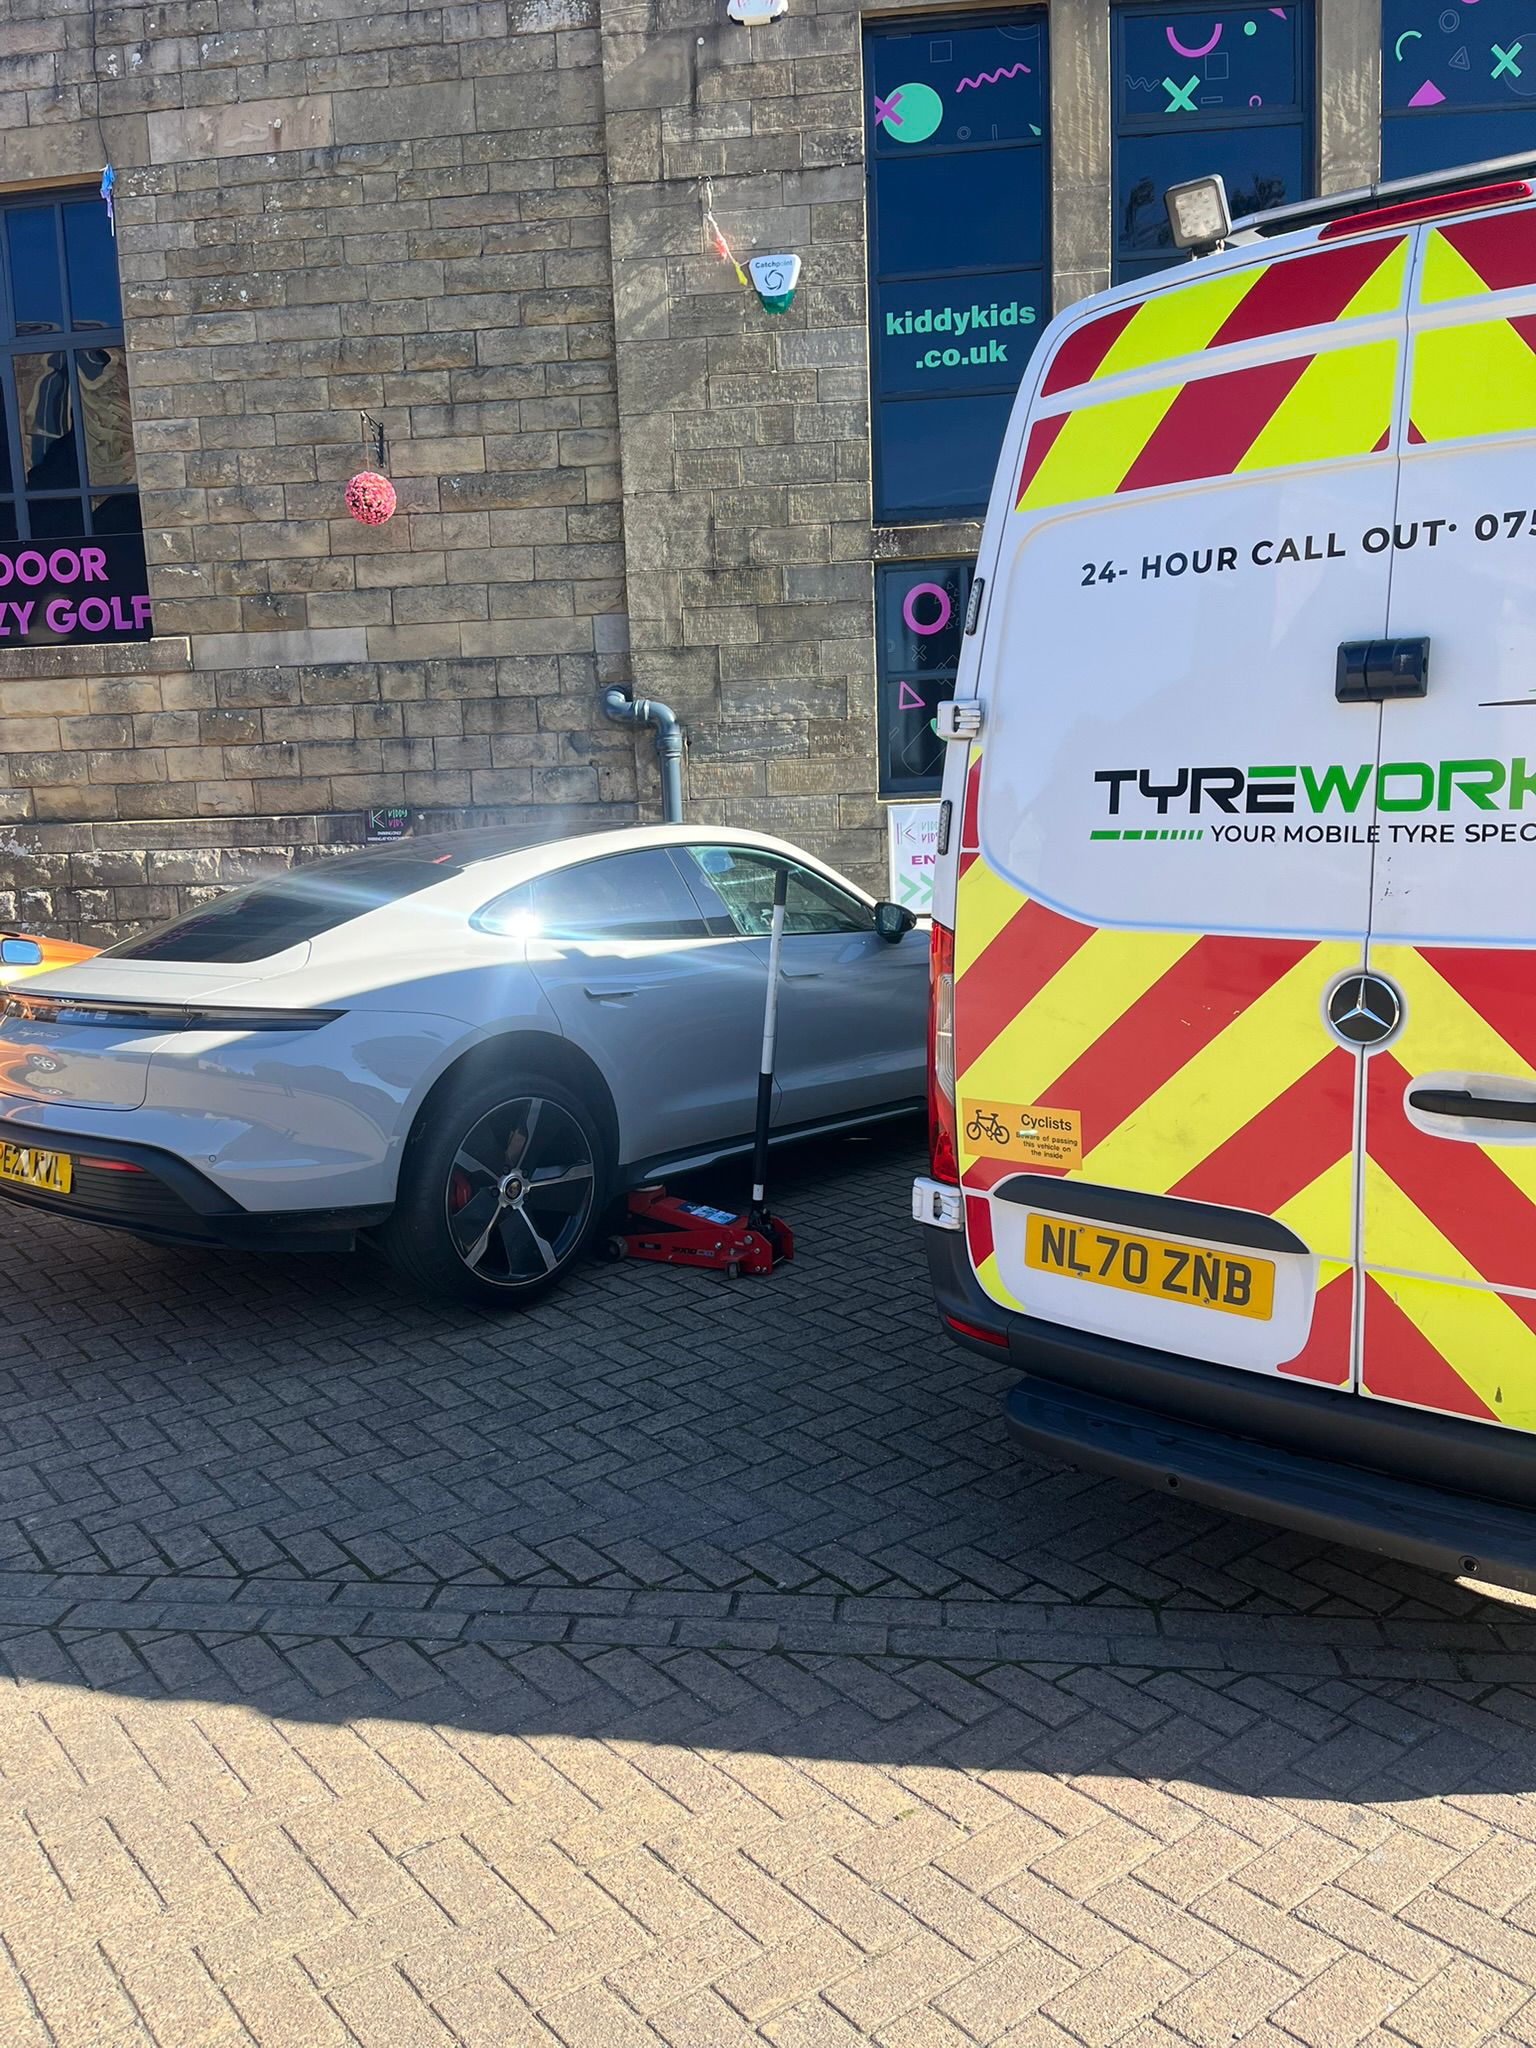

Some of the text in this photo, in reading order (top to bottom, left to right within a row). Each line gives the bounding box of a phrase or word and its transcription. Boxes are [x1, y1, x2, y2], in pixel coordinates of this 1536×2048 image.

[755, 260, 793, 269] Catchpoint
[886, 302, 1036, 336] kiddykids
[916, 340, 1008, 369] .co.uk
[1141, 546, 1238, 580] HOUR
[1251, 532, 1346, 566] CALL
[46, 594, 153, 634] GOLF
[1210, 825, 1275, 843] YOUR
[1284, 825, 1380, 843] MOBILE
[1388, 824, 1455, 843] TYRE
[911, 855, 936, 865] EN
[1021, 1113, 1072, 1131] Cyclists
[1023, 1140, 1035, 1148] this
[1037, 1143, 1060, 1152] vehicle
[1051, 1136, 1078, 1147] passing
[1044, 1151, 1063, 1159] inside
[1041, 1224, 1252, 1306] NL70 ZNB
